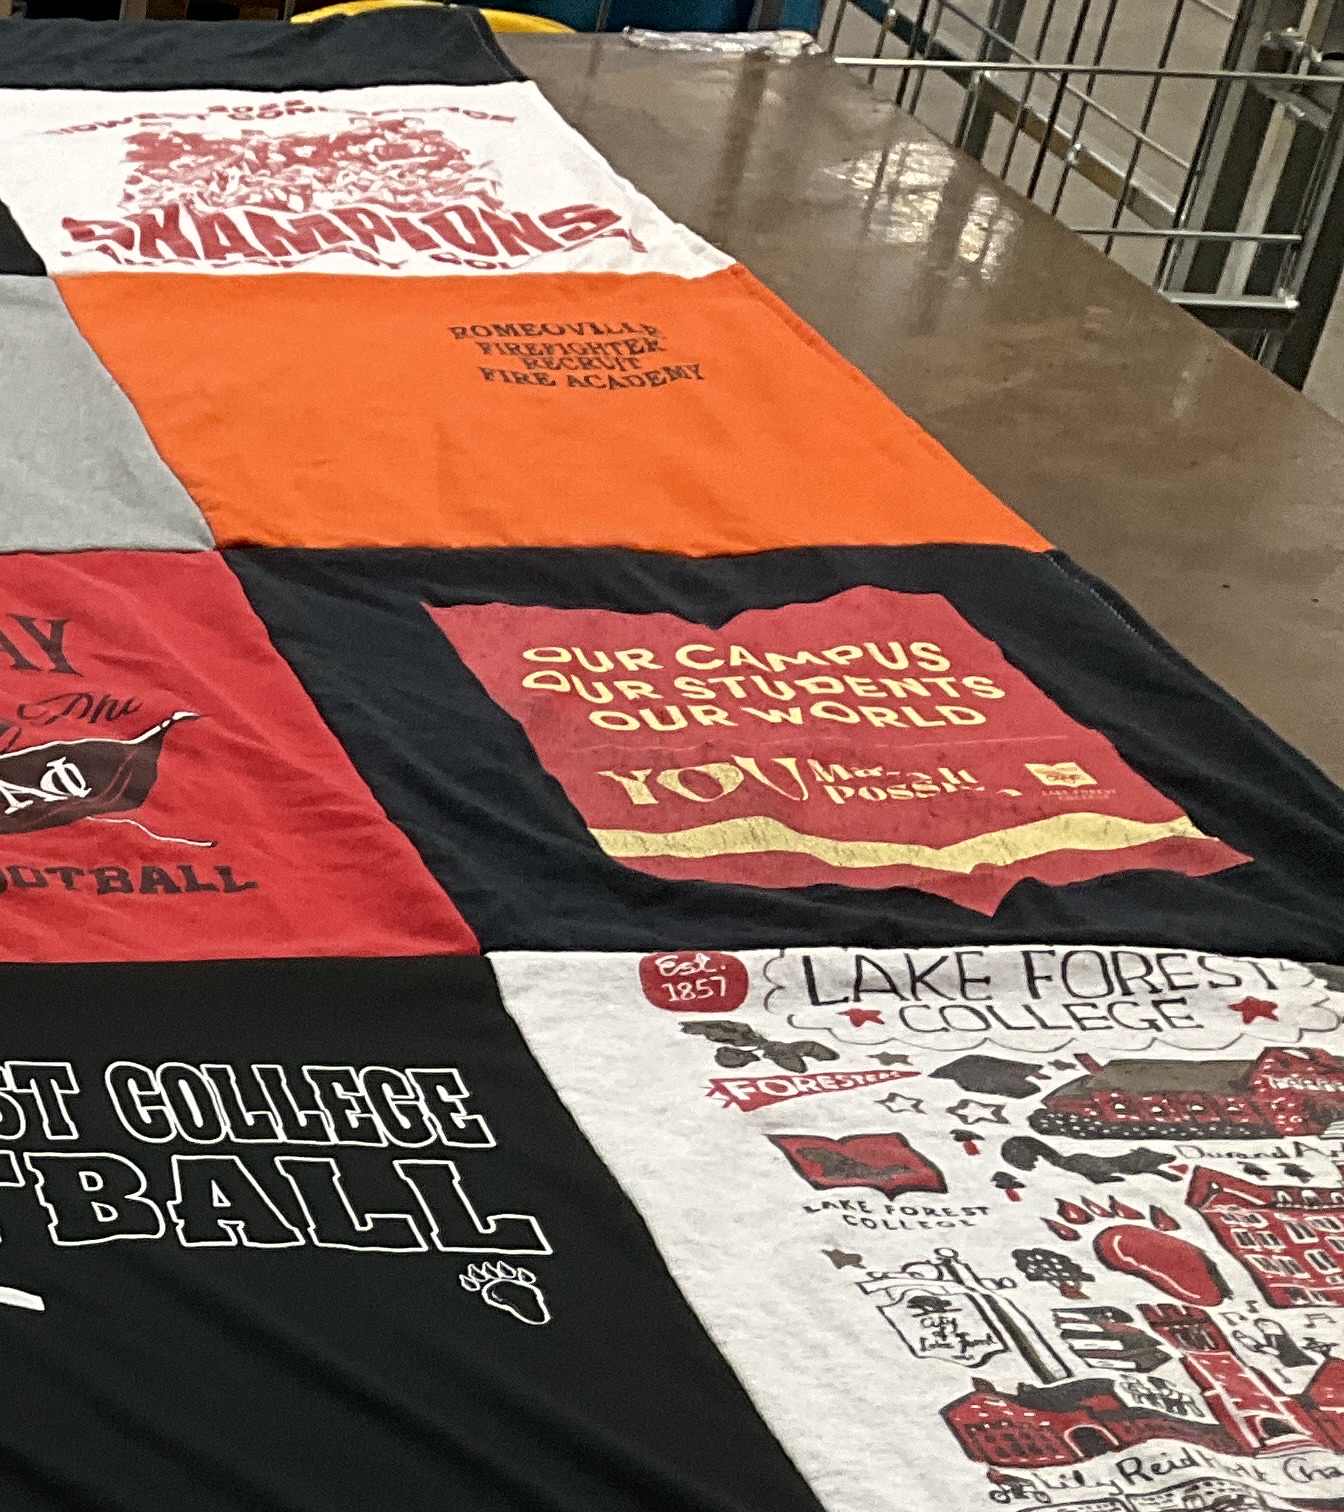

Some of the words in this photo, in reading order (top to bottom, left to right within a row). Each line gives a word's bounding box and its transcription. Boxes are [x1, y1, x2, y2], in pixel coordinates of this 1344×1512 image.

[477, 366, 557, 388] FIRE
[566, 363, 705, 390] ACADEMY
[521, 646, 659, 673] OUR
[674, 641, 953, 673] CAMPUS
[521, 669, 658, 704] OUR
[681, 674, 1007, 703] STUDENTS
[587, 704, 731, 733] OUR
[739, 698, 989, 728] WORLD
[597, 755, 811, 806] YOU
[653, 951, 728, 977] Est.
[802, 950, 995, 1007] LAKE
[1020, 948, 1284, 1002] FOREST
[661, 975, 728, 1002] 1857
[898, 997, 1205, 1034] COLLEGE
[105, 1061, 497, 1149] COLLEGE
[802, 1198, 872, 1216] LAKE
[883, 1203, 993, 1218] FOREST
[1115, 1446, 1200, 1486] Reid
